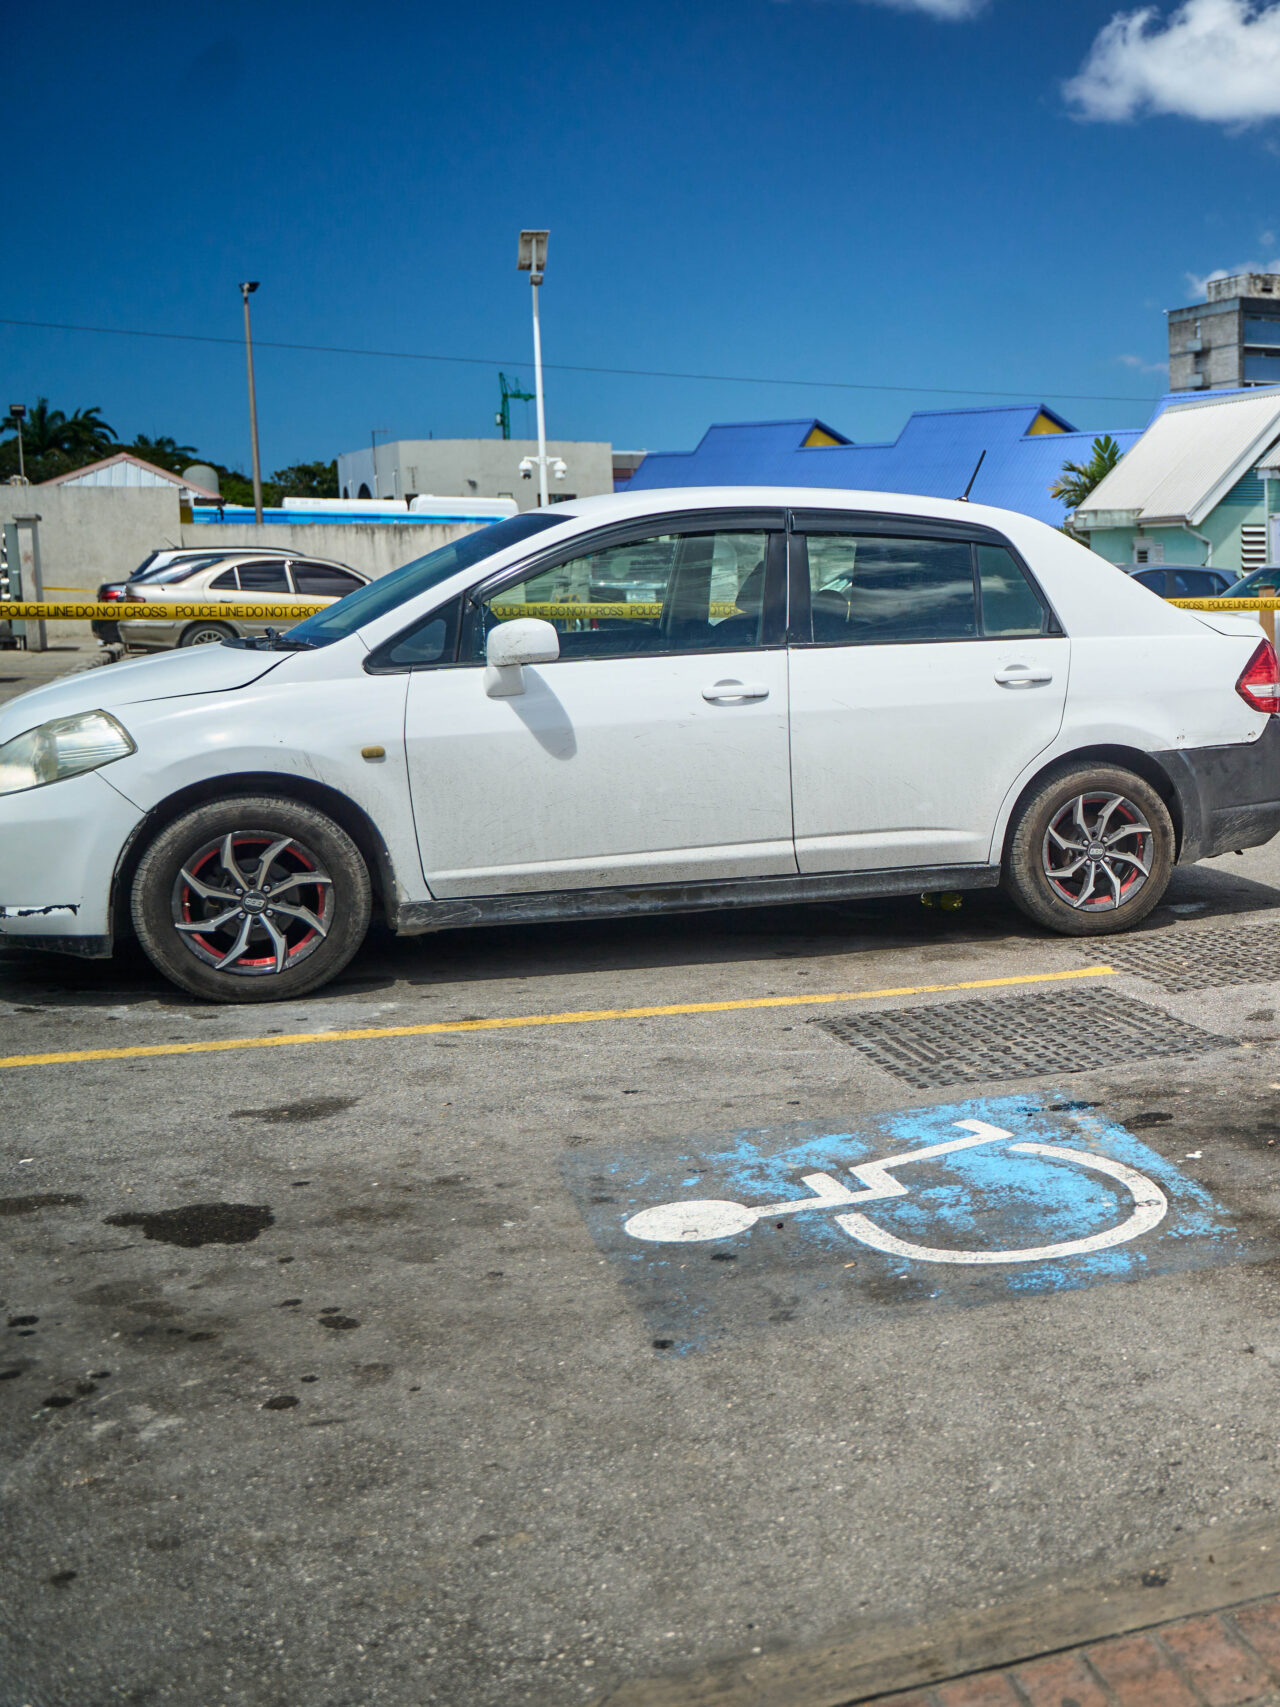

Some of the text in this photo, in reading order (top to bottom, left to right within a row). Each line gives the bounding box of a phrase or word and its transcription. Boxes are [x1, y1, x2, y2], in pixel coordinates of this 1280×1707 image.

[1208, 600, 1232, 609] POLICE
[1233, 600, 1248, 609] LINE
[1250, 600, 1260, 609] DO
[1261, 600, 1274, 609] NOT
[0, 605, 168, 618] POLICE LINE DO NOT CROSS
[175, 606, 323, 617] POLICE LINE DO NOT CRO
[527, 606, 549, 617] LINE
[550, 606, 566, 617] DO
[568, 606, 587, 617] NOT
[589, 606, 624, 617] CROSS
